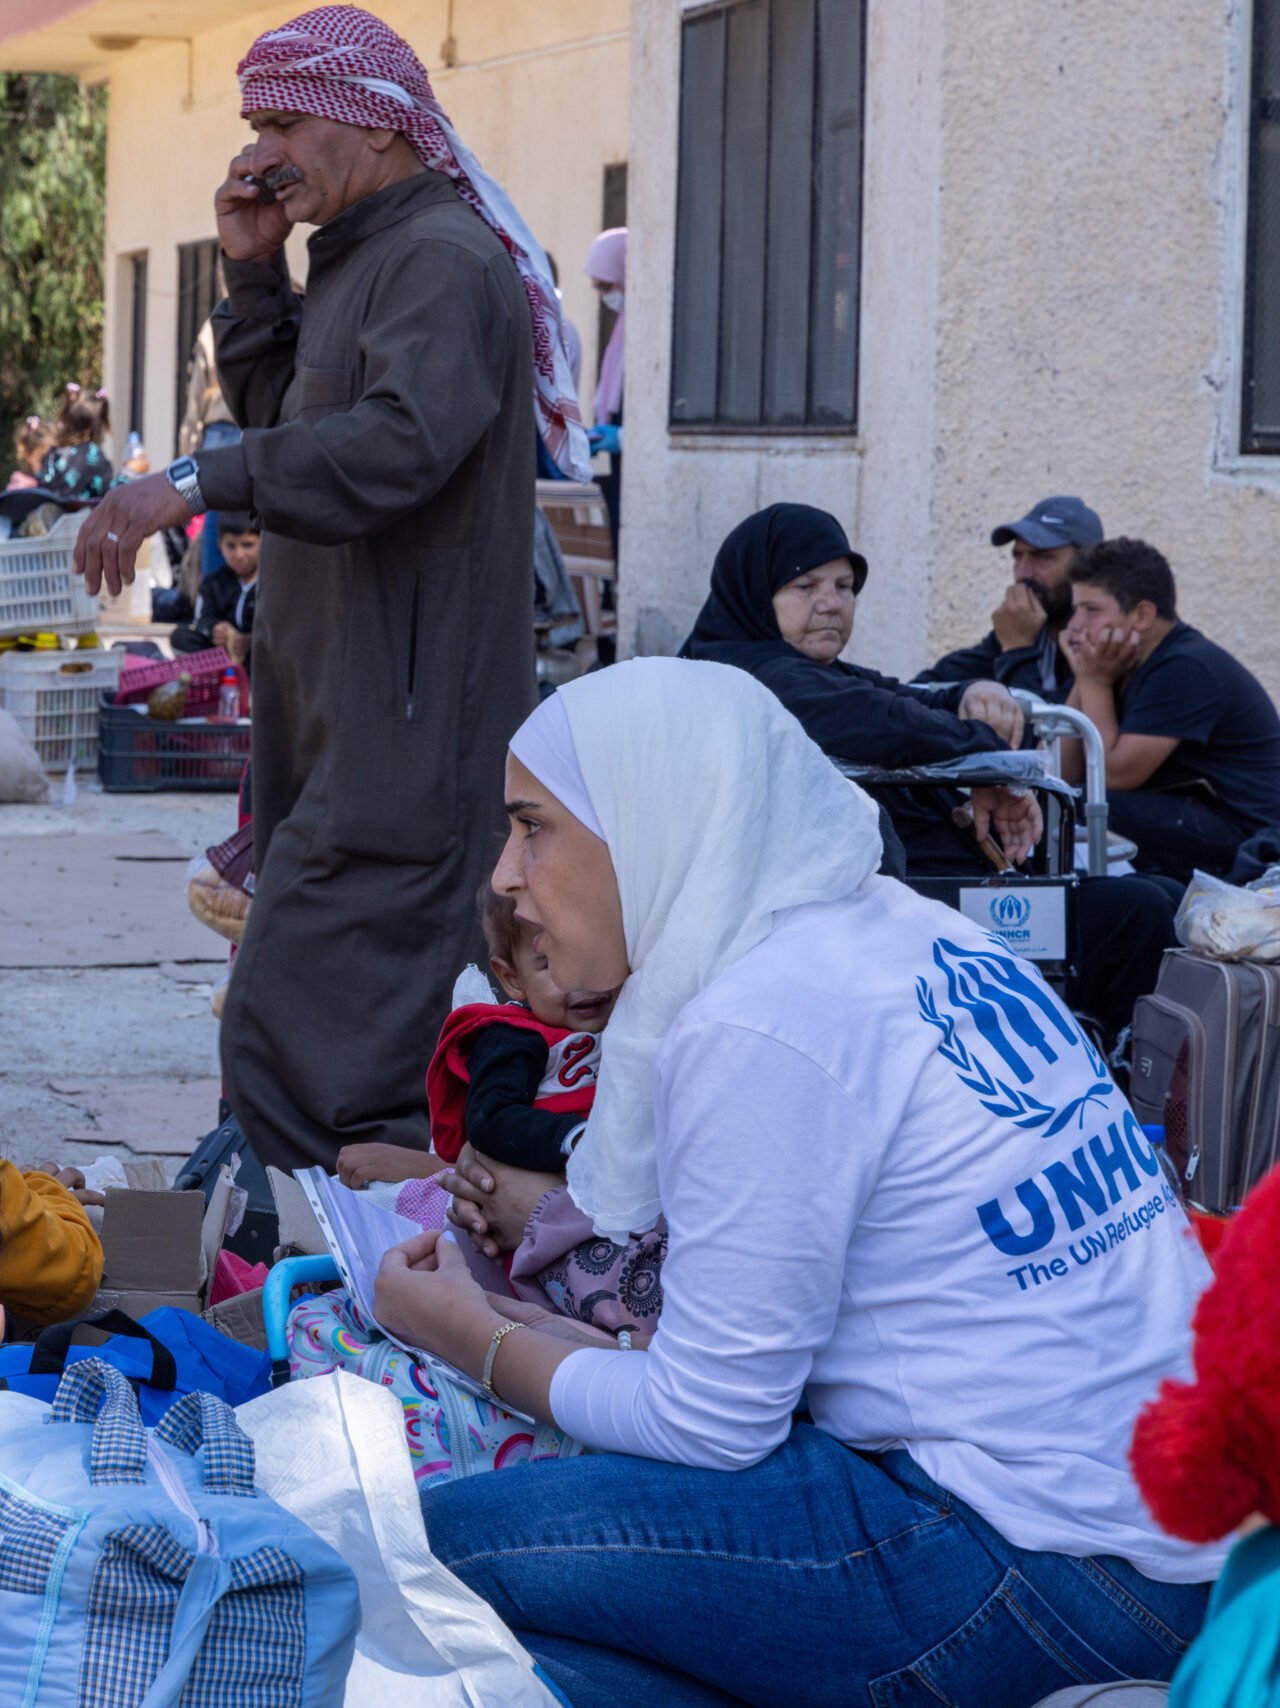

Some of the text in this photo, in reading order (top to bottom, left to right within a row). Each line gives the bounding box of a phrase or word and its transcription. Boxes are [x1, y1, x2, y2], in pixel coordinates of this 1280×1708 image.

[1007, 1257, 1069, 1291] The
[1068, 1230, 1108, 1265] UN
[1103, 1195, 1165, 1249] Refugee
